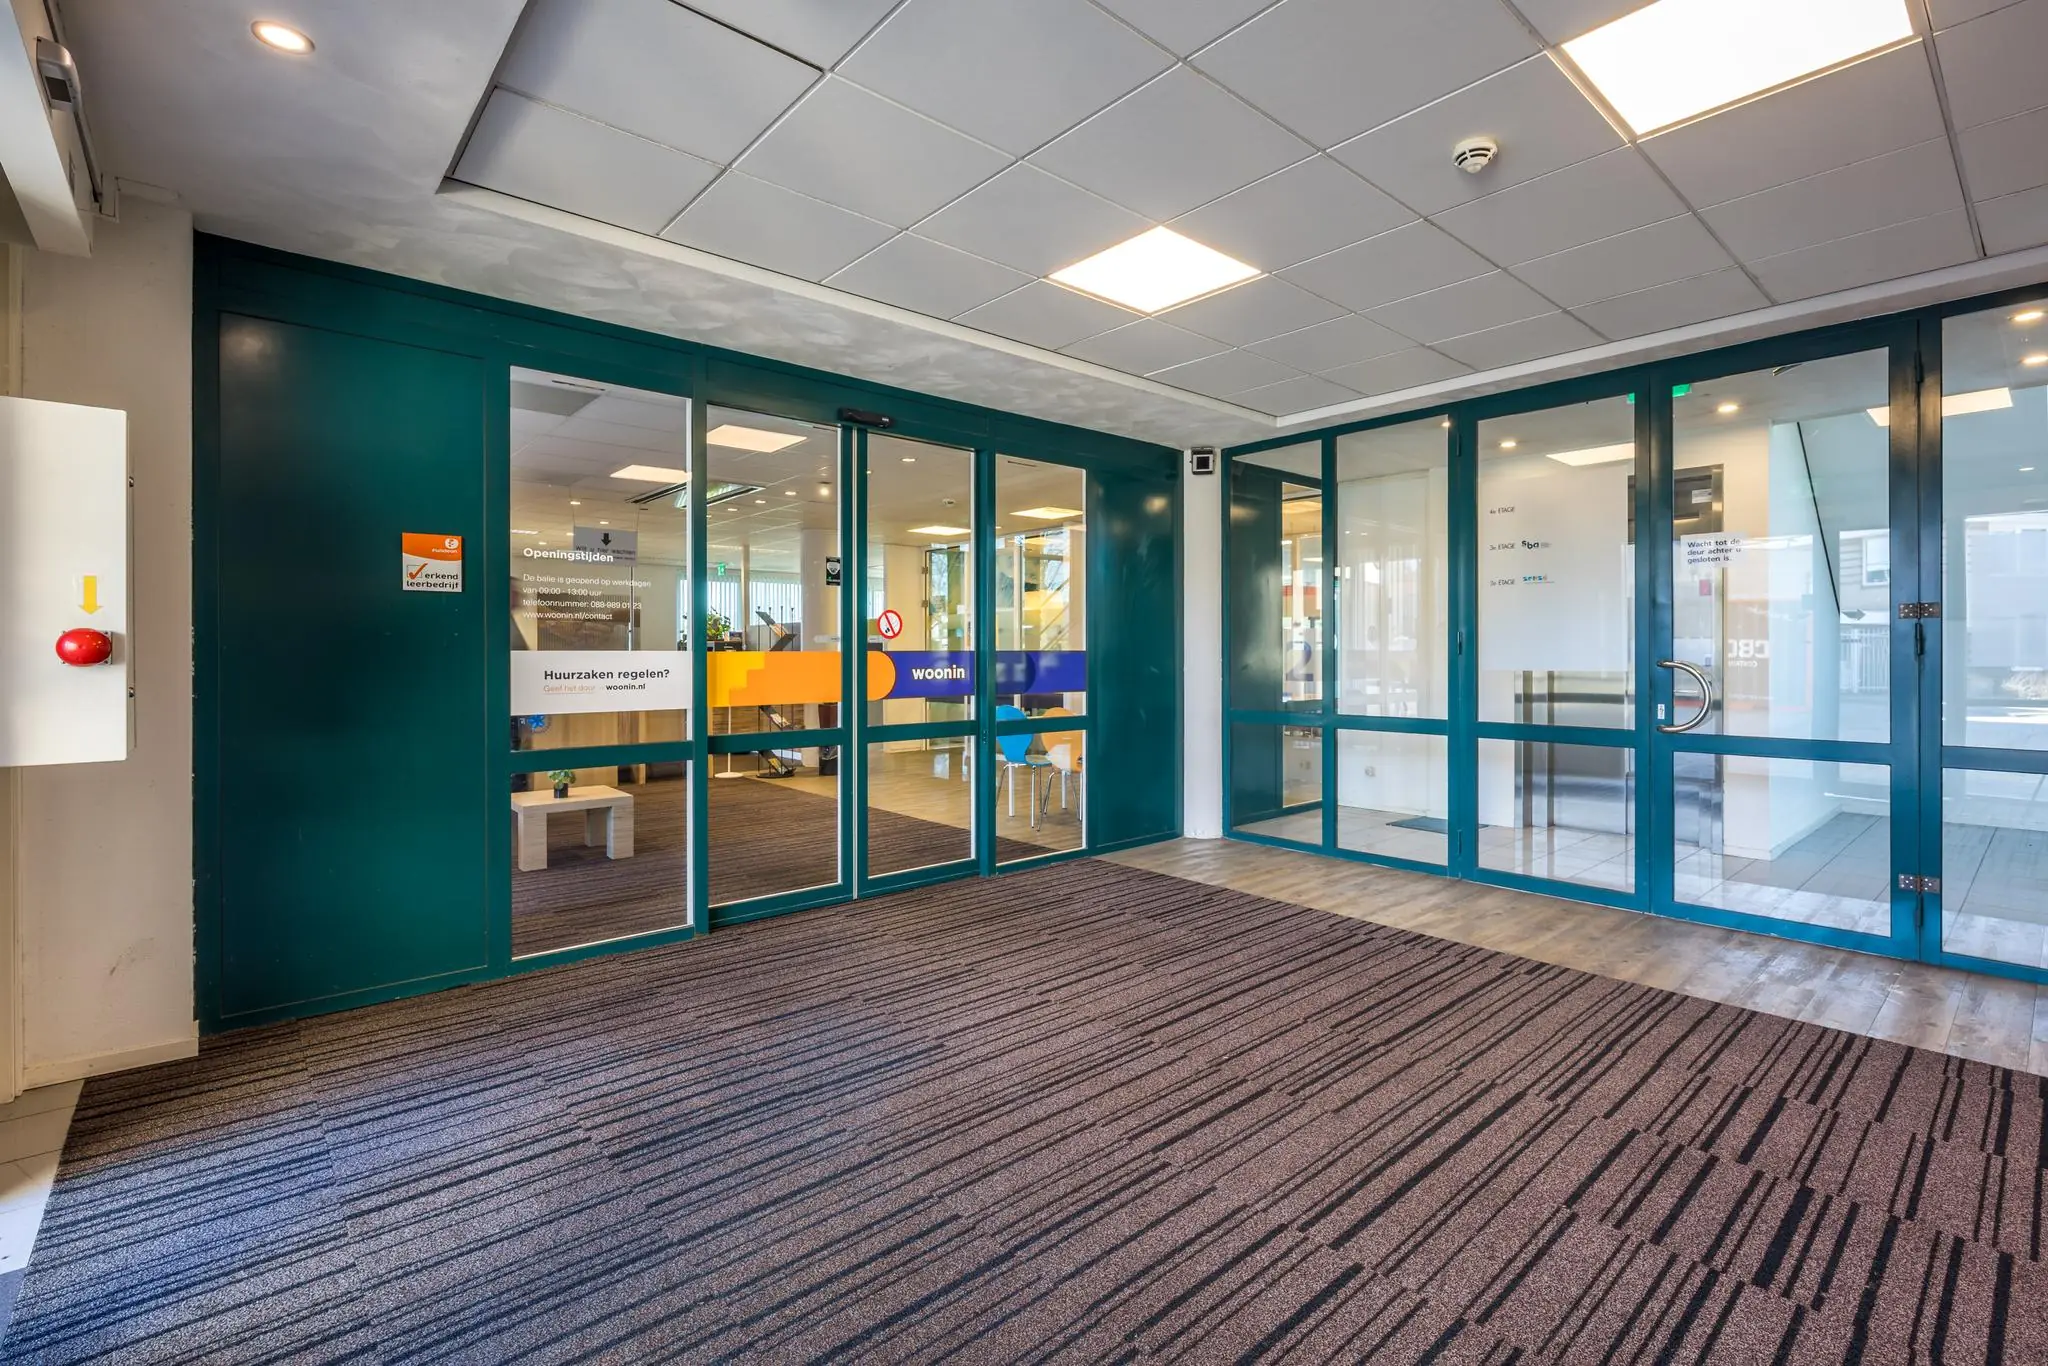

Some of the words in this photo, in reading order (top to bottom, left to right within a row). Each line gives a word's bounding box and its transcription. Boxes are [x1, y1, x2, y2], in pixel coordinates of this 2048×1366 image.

[523, 547, 614, 562] Openingstijden
[1708, 547, 1733, 555] achter
[1687, 556, 1721, 565] gesloten
[425, 572, 459, 580] erkend
[523, 573, 536, 582] De
[536, 574, 556, 583] balie
[557, 575, 564, 584] is
[565, 576, 600, 587] geopend
[600, 578, 611, 587] op
[611, 578, 652, 588] werkdagen
[406, 580, 459, 590] leerbedrijf
[522, 586, 537, 594] van
[538, 587, 561, 595] 09:00
[567, 588, 588, 596] 13:00
[588, 589, 602, 597] uur
[522, 598, 590, 608] telefoonnummer:
[523, 611, 613, 621] www.woonin.nl/contact
[543, 670, 614, 680] Huurzaken
[617, 669, 670, 681] regelen?
[911, 664, 965, 680] woonin
[605, 683, 646, 691] woonin.nl
